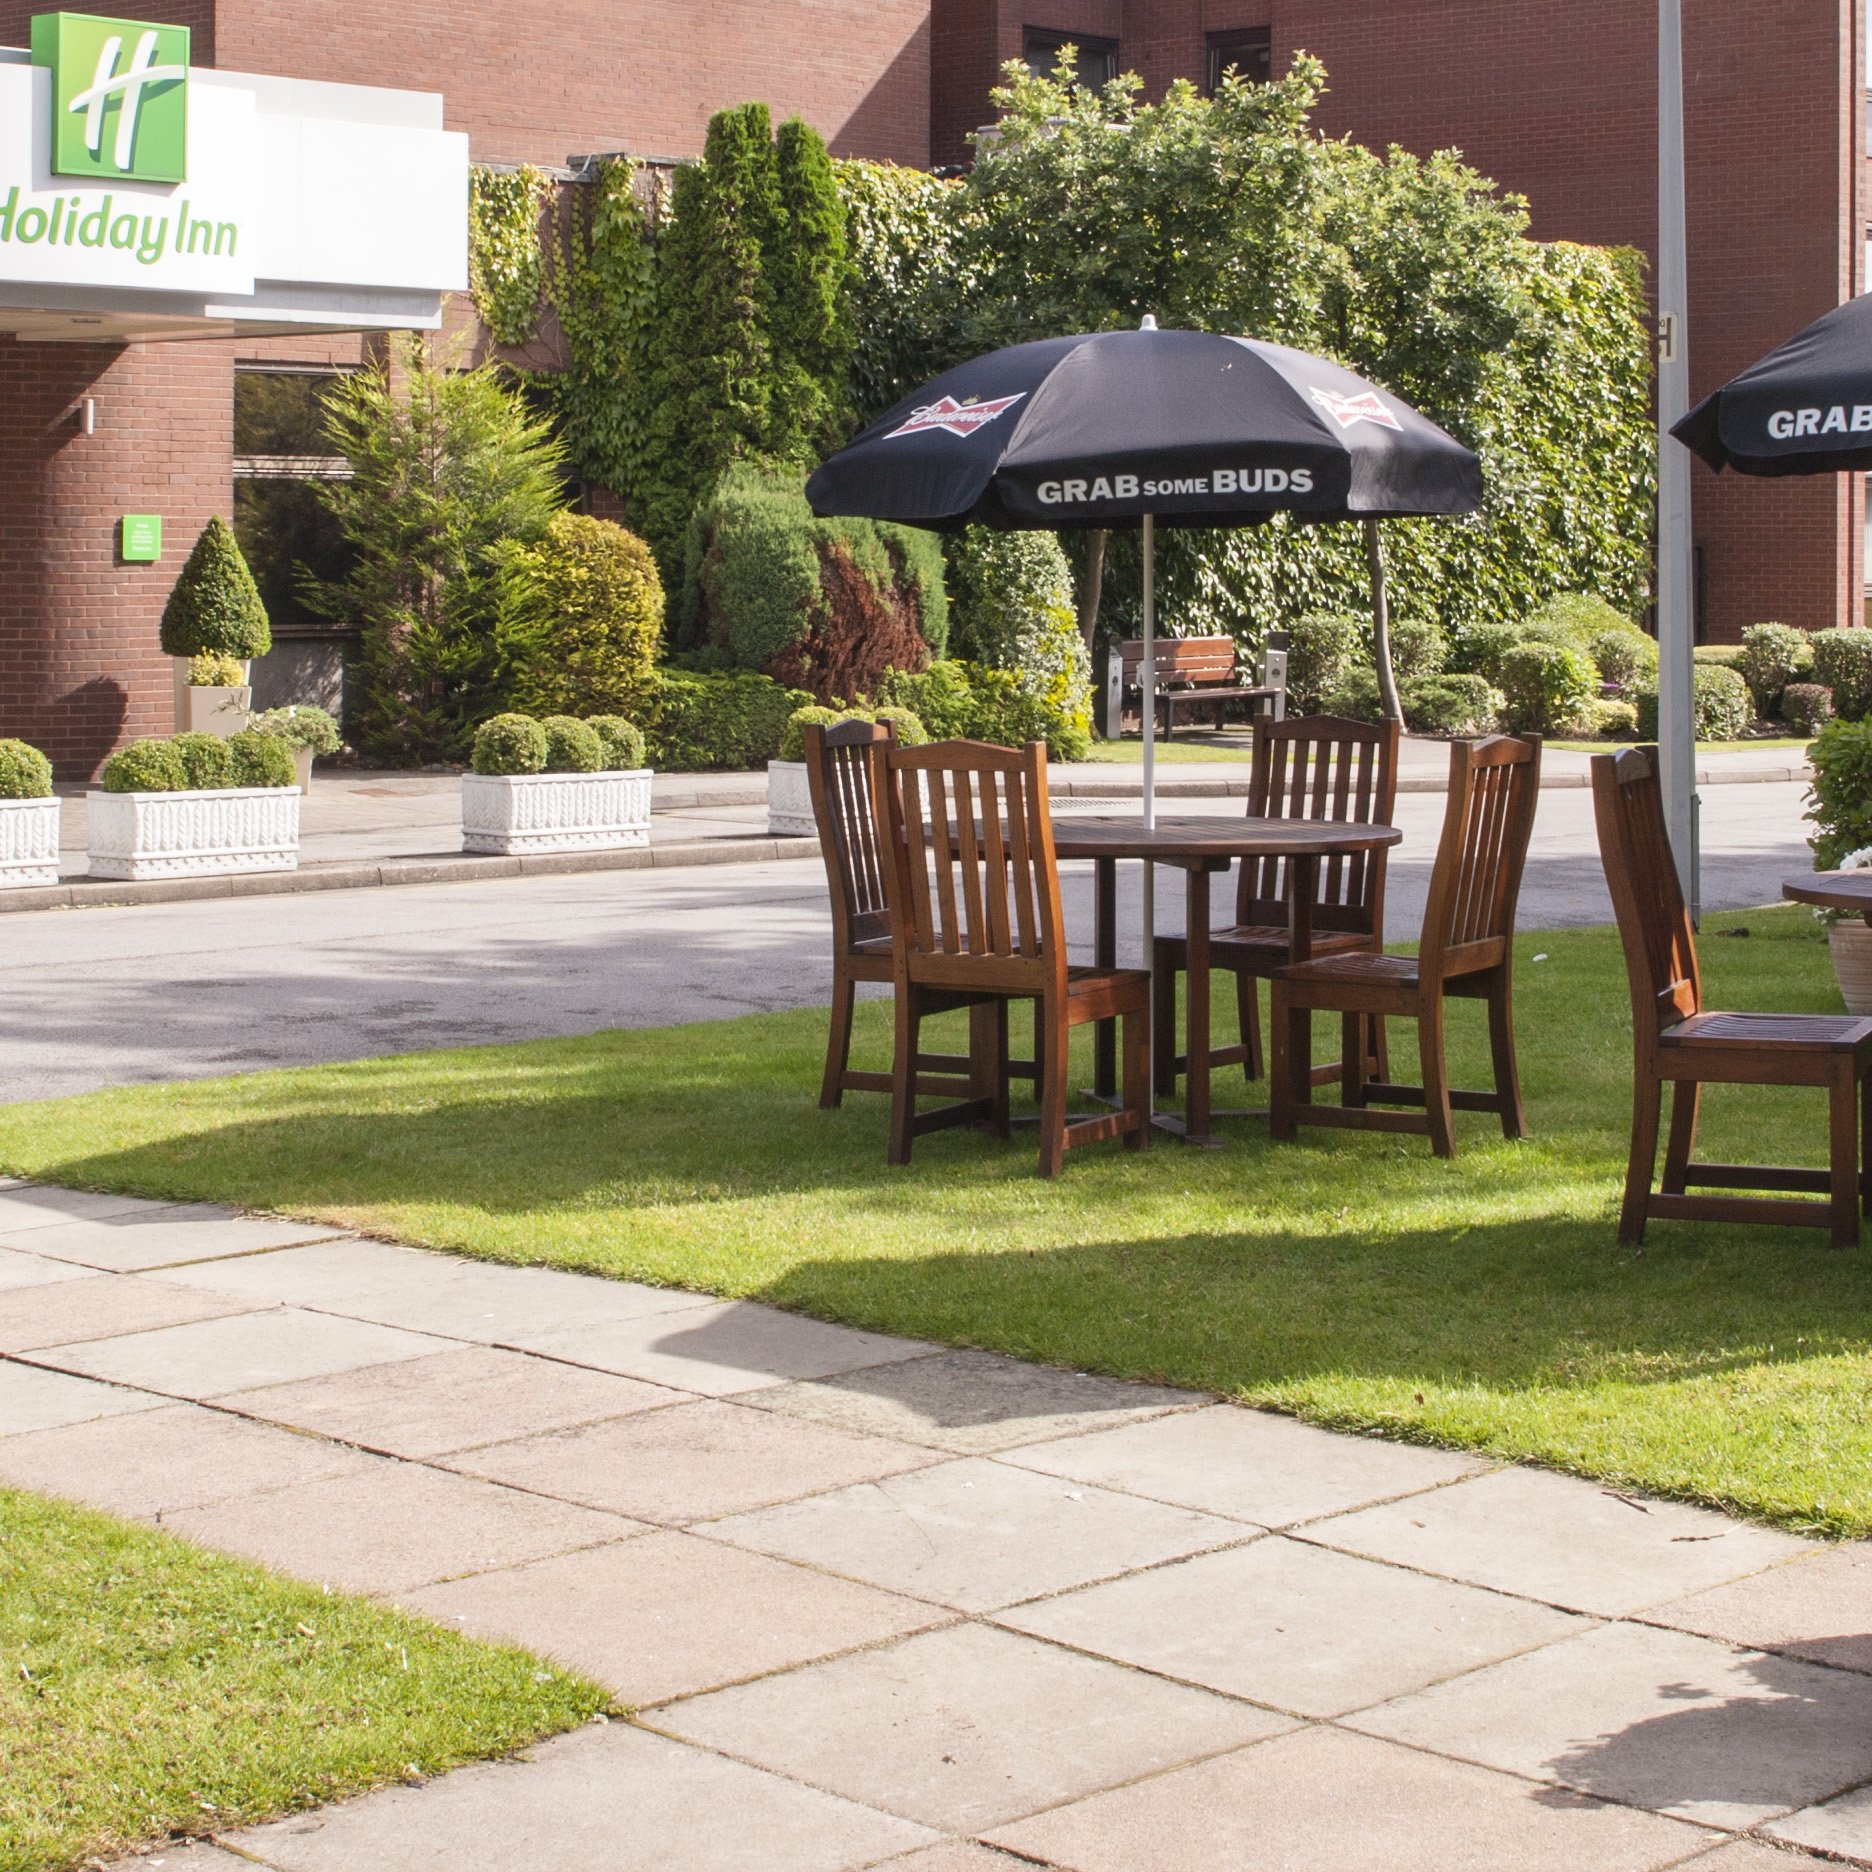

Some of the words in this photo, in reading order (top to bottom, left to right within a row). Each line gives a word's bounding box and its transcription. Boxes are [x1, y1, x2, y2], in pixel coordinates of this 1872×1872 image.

[174, 199, 238, 258] Inn
[1036, 473, 1140, 504] GRAB
[1142, 478, 1209, 496] SOME
[1212, 468, 1315, 494] BUDS
